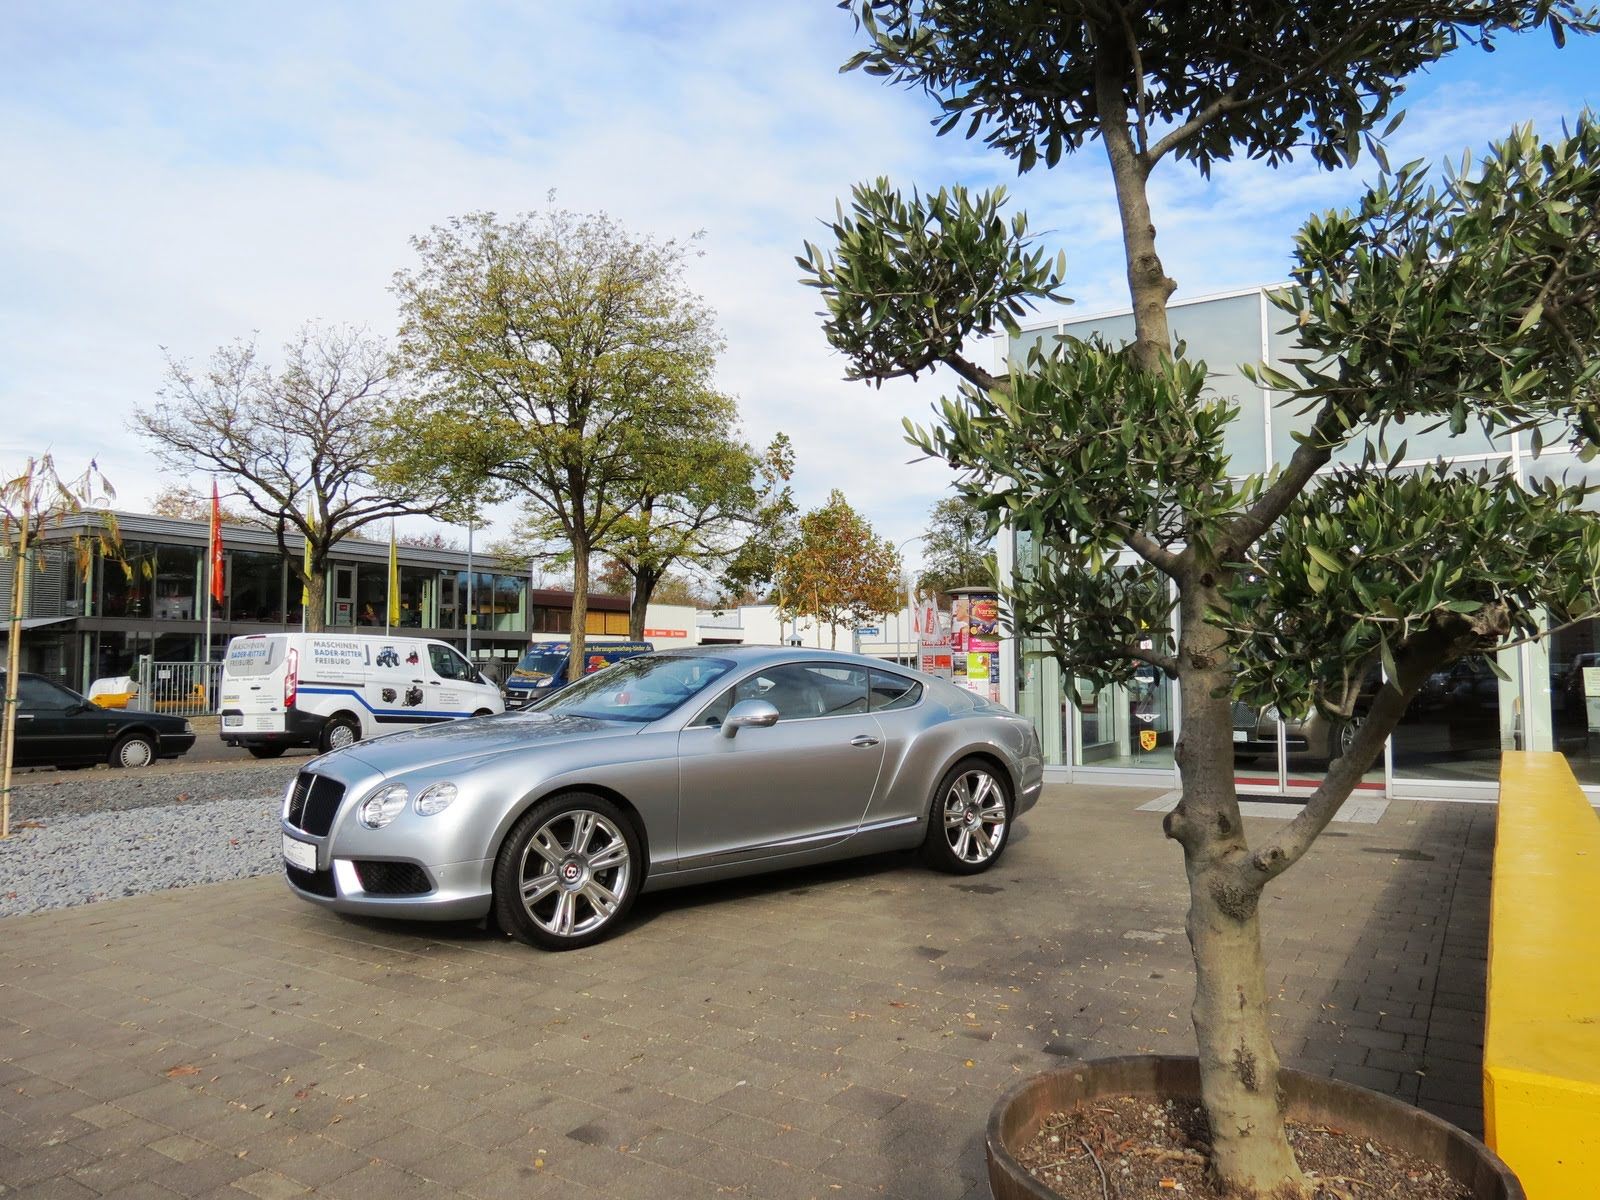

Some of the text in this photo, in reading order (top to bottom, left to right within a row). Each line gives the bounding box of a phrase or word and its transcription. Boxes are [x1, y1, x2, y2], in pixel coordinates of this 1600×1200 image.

[313, 641, 359, 650] MASCHINEN
[231, 650, 267, 658] BADER-RITTER
[314, 649, 363, 657] BADER-RITTER
[314, 657, 351, 666] FREIBURG
